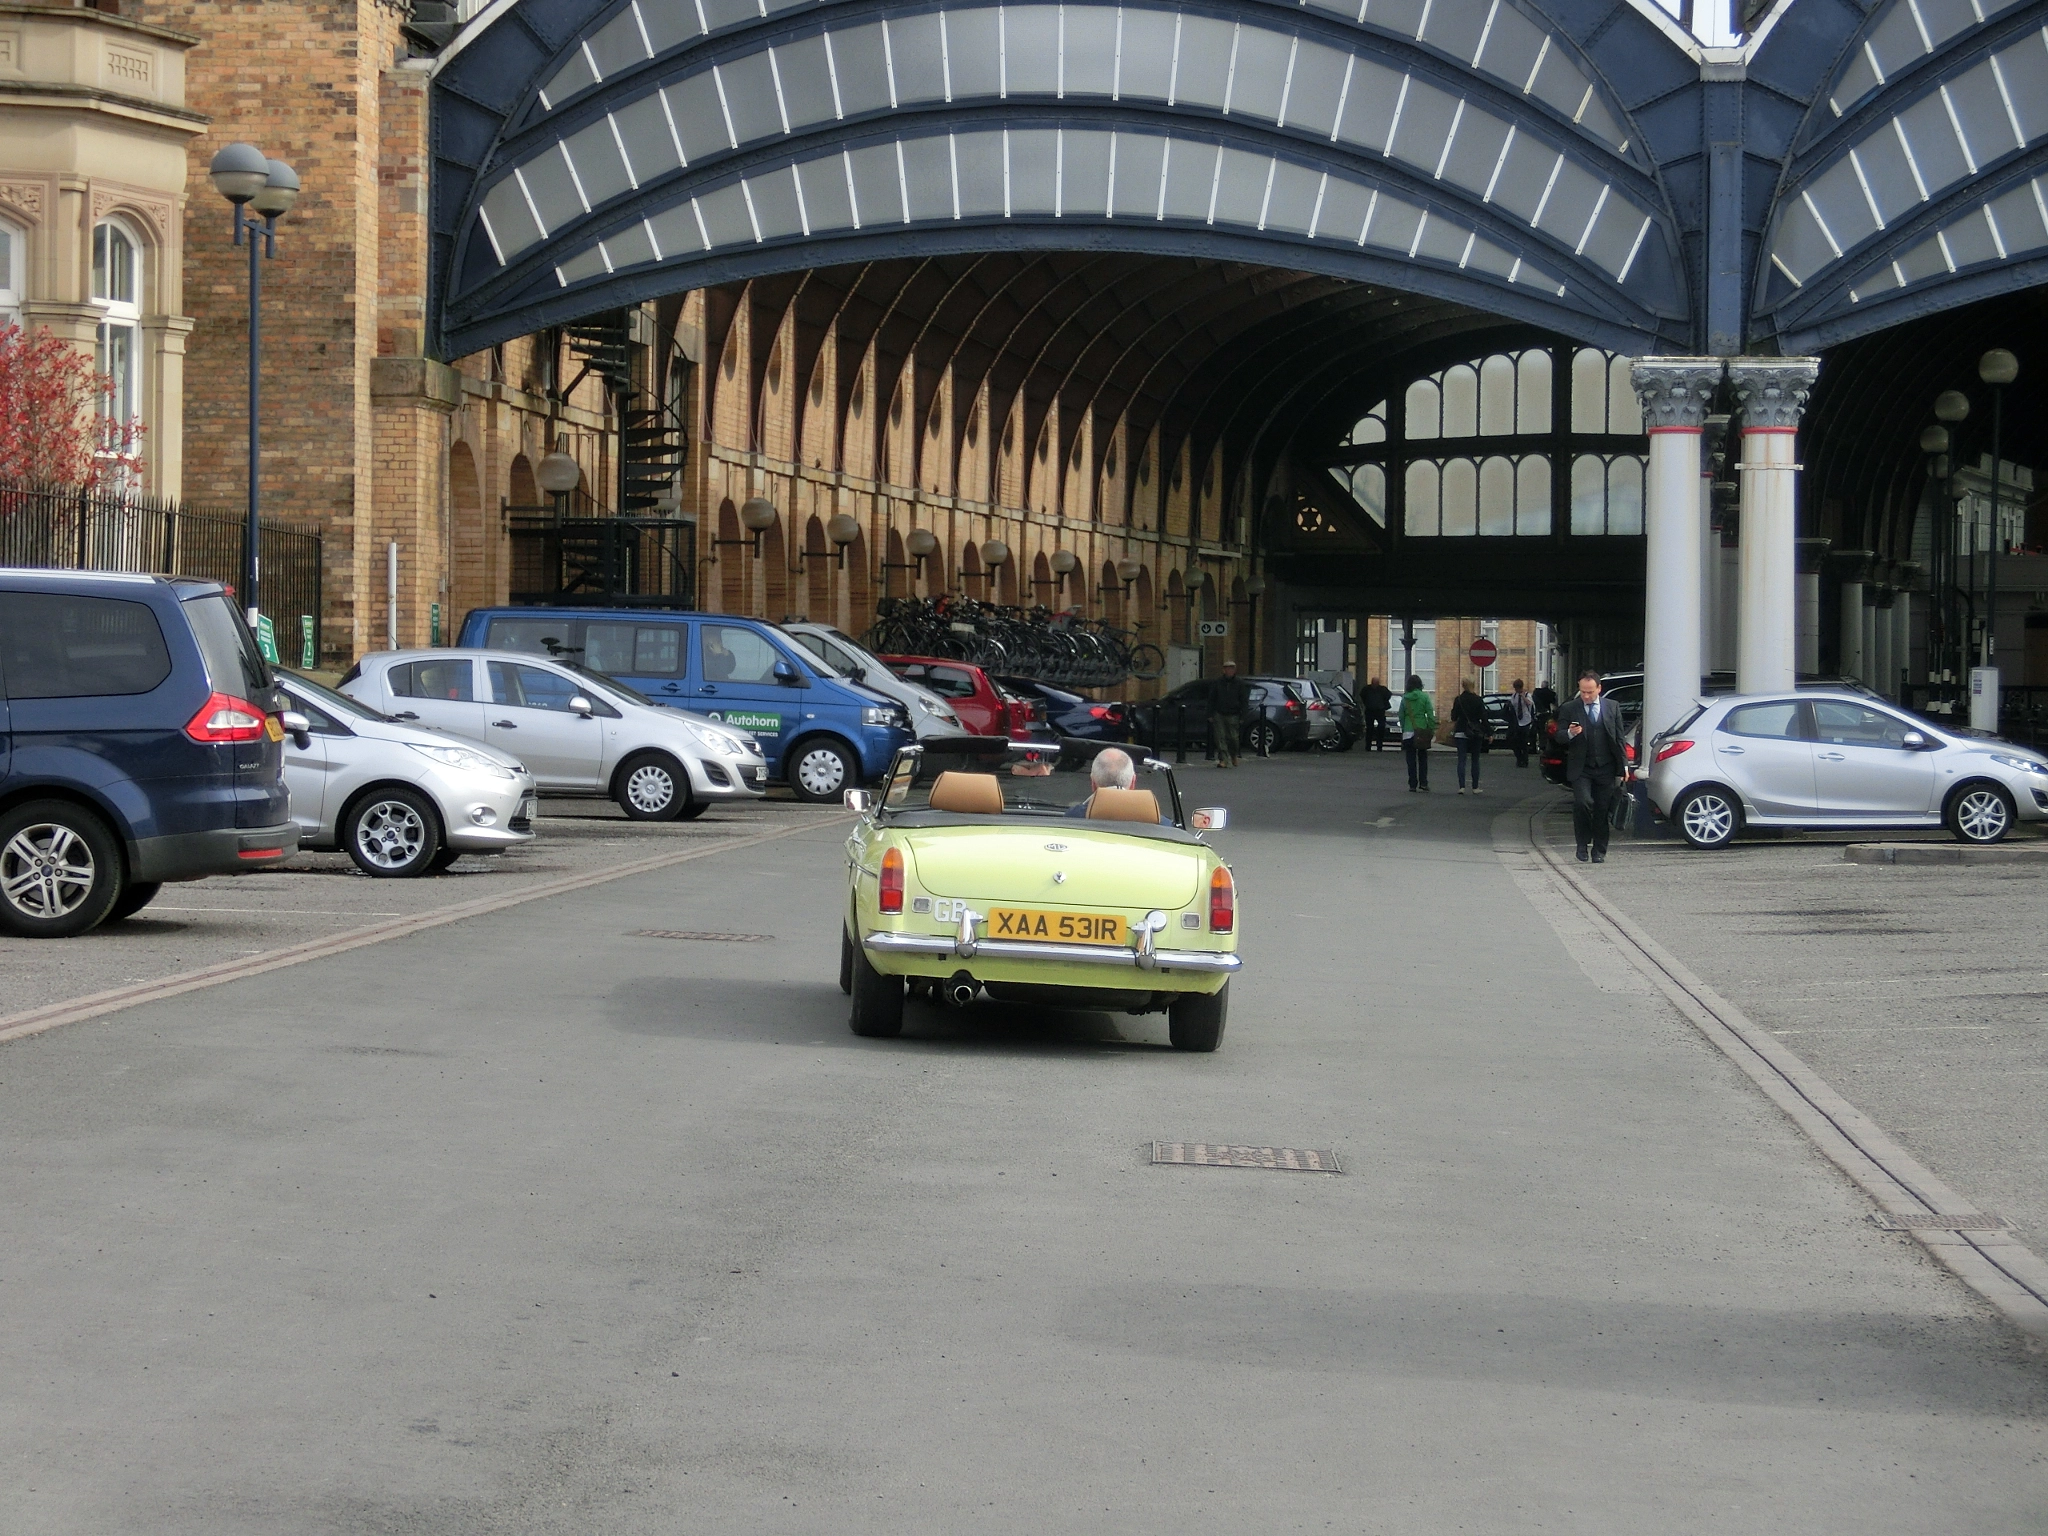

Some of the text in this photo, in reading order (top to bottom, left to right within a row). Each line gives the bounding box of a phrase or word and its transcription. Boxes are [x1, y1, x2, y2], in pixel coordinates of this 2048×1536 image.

[726, 714, 779, 727] Autohorn
[934, 899, 967, 923] GB
[997, 912, 1117, 940] XAA 531R
